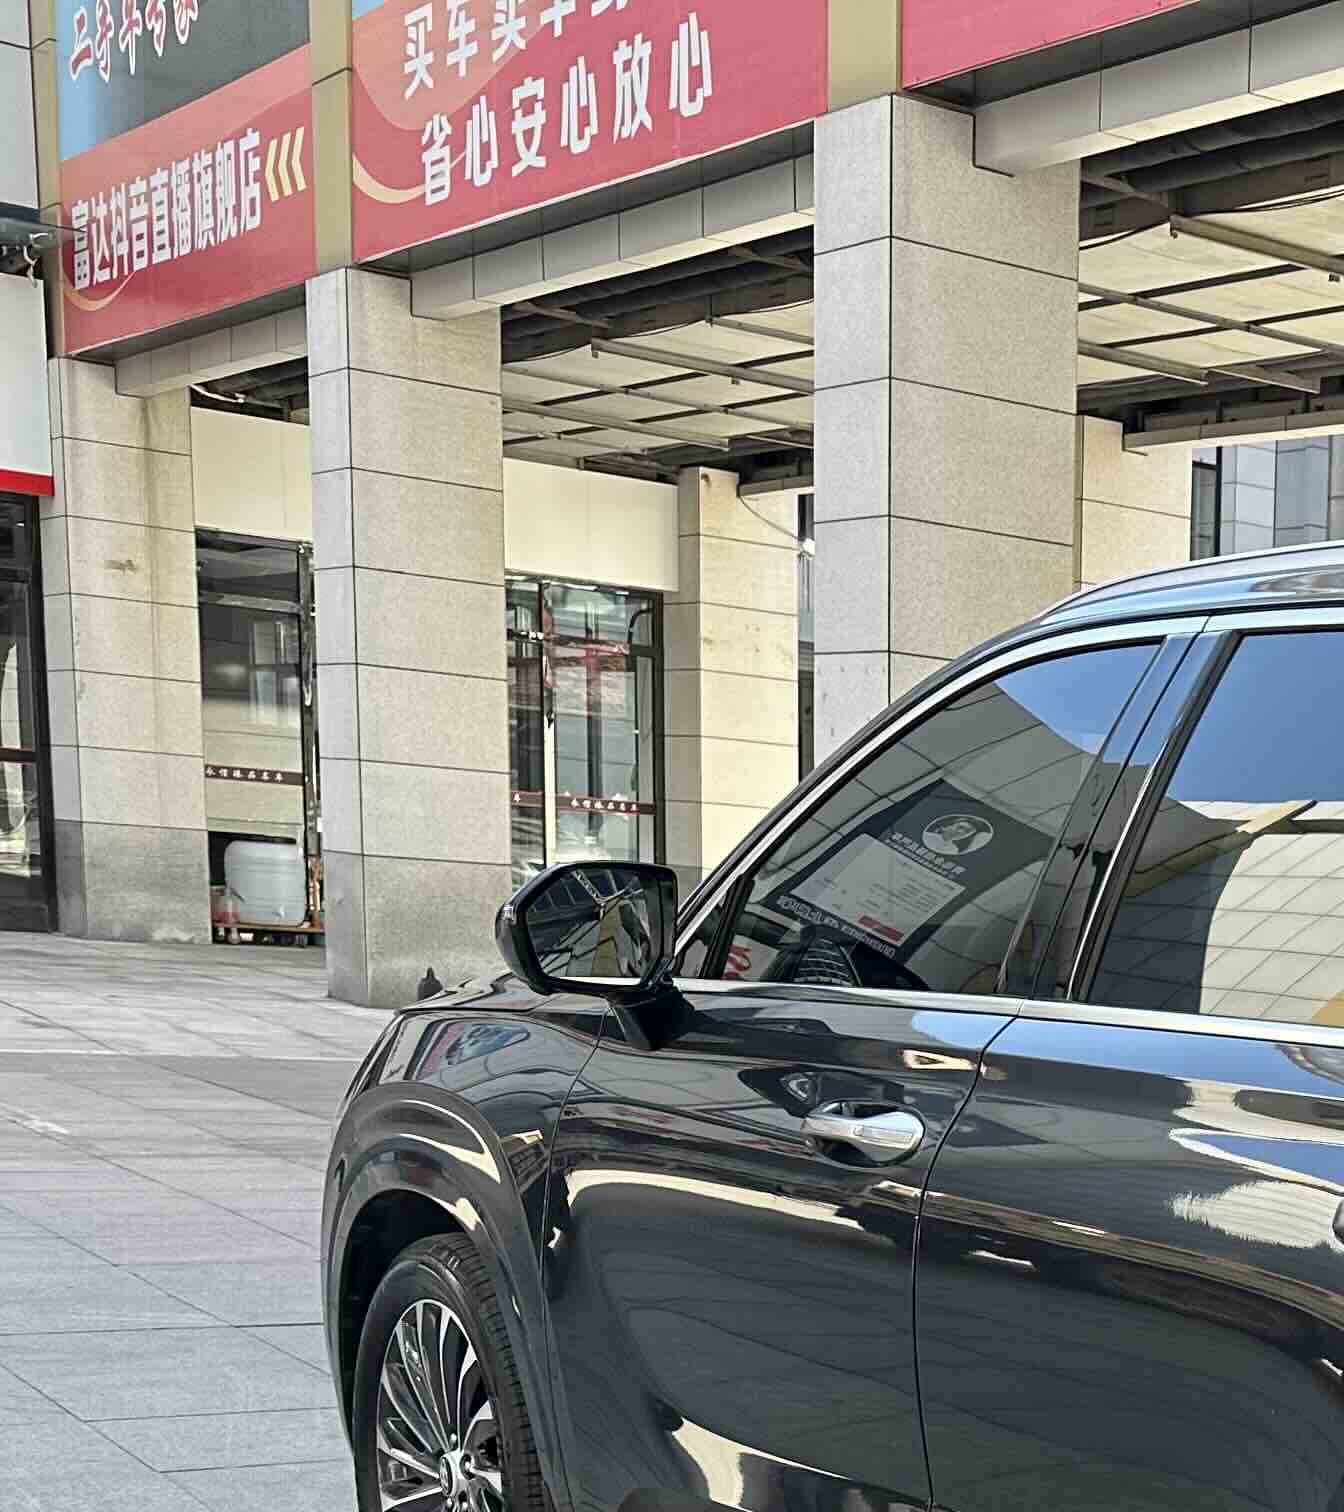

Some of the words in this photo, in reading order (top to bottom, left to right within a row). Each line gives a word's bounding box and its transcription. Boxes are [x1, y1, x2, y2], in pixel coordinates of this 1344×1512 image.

[421, 12, 712, 205] 省心安心放心
[71, 128, 261, 289] 富达抖音直播旗舰店
